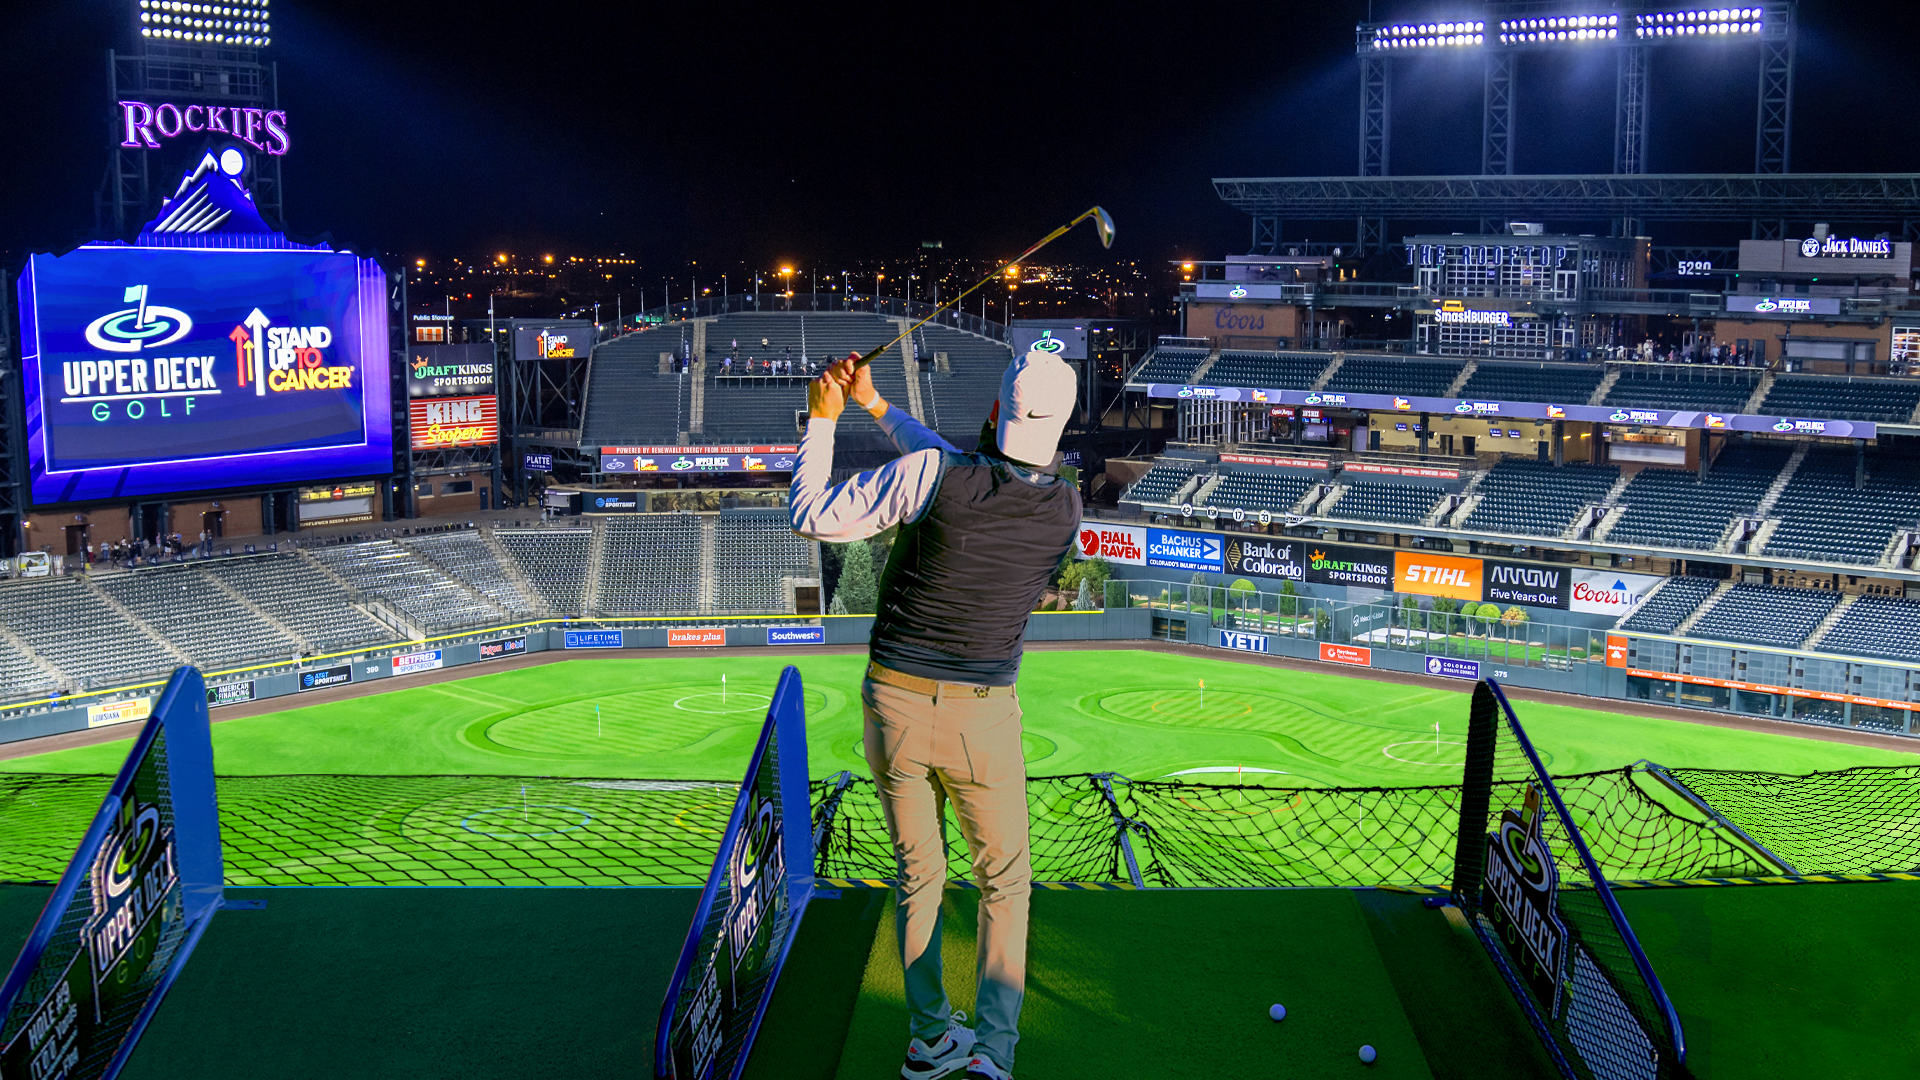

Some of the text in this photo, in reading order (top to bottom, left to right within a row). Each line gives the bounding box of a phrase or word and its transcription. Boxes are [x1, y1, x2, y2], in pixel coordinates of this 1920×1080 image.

[119, 101, 290, 155] ROCKIES
[1822, 236, 1848, 252] JACK
[1405, 244, 1446, 266] THE
[1462, 245, 1566, 267] ROOFTOP
[1678, 261, 1712, 276] 5280
[1215, 306, 1264, 330] Coors
[267, 326, 332, 350] STAND
[548, 336, 568, 344] STAND
[548, 348, 574, 358] CANCER
[63, 356, 217, 396] UPPER DECK
[268, 366, 352, 392] CANCER
[414, 364, 493, 379] DRAFTKINGS
[434, 375, 493, 386] SPORTSBOOK
[92, 397, 196, 422] GOLF
[427, 400, 482, 424] KING
[426, 424, 484, 446] Soopers
[526, 456, 550, 465] PLATTE
[1182, 507, 1190, 516] 42
[1235, 511, 1242, 519] 17
[1260, 514, 1268, 523] 33
[1162, 534, 1201, 547] BACHUS
[1150, 544, 1201, 558] SCHANKER
[1243, 542, 1291, 560] Bank of
[1150, 559, 1180, 567] COLORADO'S
[1209, 563, 1220, 571] FIRM
[1243, 558, 1302, 577] Colorado
[1312, 558, 1388, 574] DRAFTKINGS
[1329, 572, 1387, 584] SPORTSBOOK
[1404, 564, 1471, 587] STIHL
[1490, 588, 1558, 604] Five Years Out
[1574, 582, 1619, 604] Coors
[672, 633, 721, 642] brakes plus
[772, 632, 814, 640] Southwest
[1224, 632, 1265, 651] YETI
[481, 645, 502, 655] Exxon
[398, 652, 436, 666] BETFRED
[1443, 662, 1476, 670] COLORADO
[366, 665, 379, 674] 390
[400, 662, 435, 672] SPORTSBOOK
[1494, 670, 1508, 678] 375
[314, 674, 348, 685] SPORTSNET
[219, 682, 249, 693] AMERICAN
[219, 689, 250, 700] FINANCING
[92, 712, 120, 722] LOUISIANA
[122, 709, 131, 717] HOT
[1486, 844, 1557, 973] UPPER DECK
[734, 877, 764, 958] UPPER
[97, 886, 144, 972] UPPER
[1494, 902, 1540, 980] GOLF
[690, 986, 708, 1034] HOLE
[28, 1000, 57, 1051] HOLE
